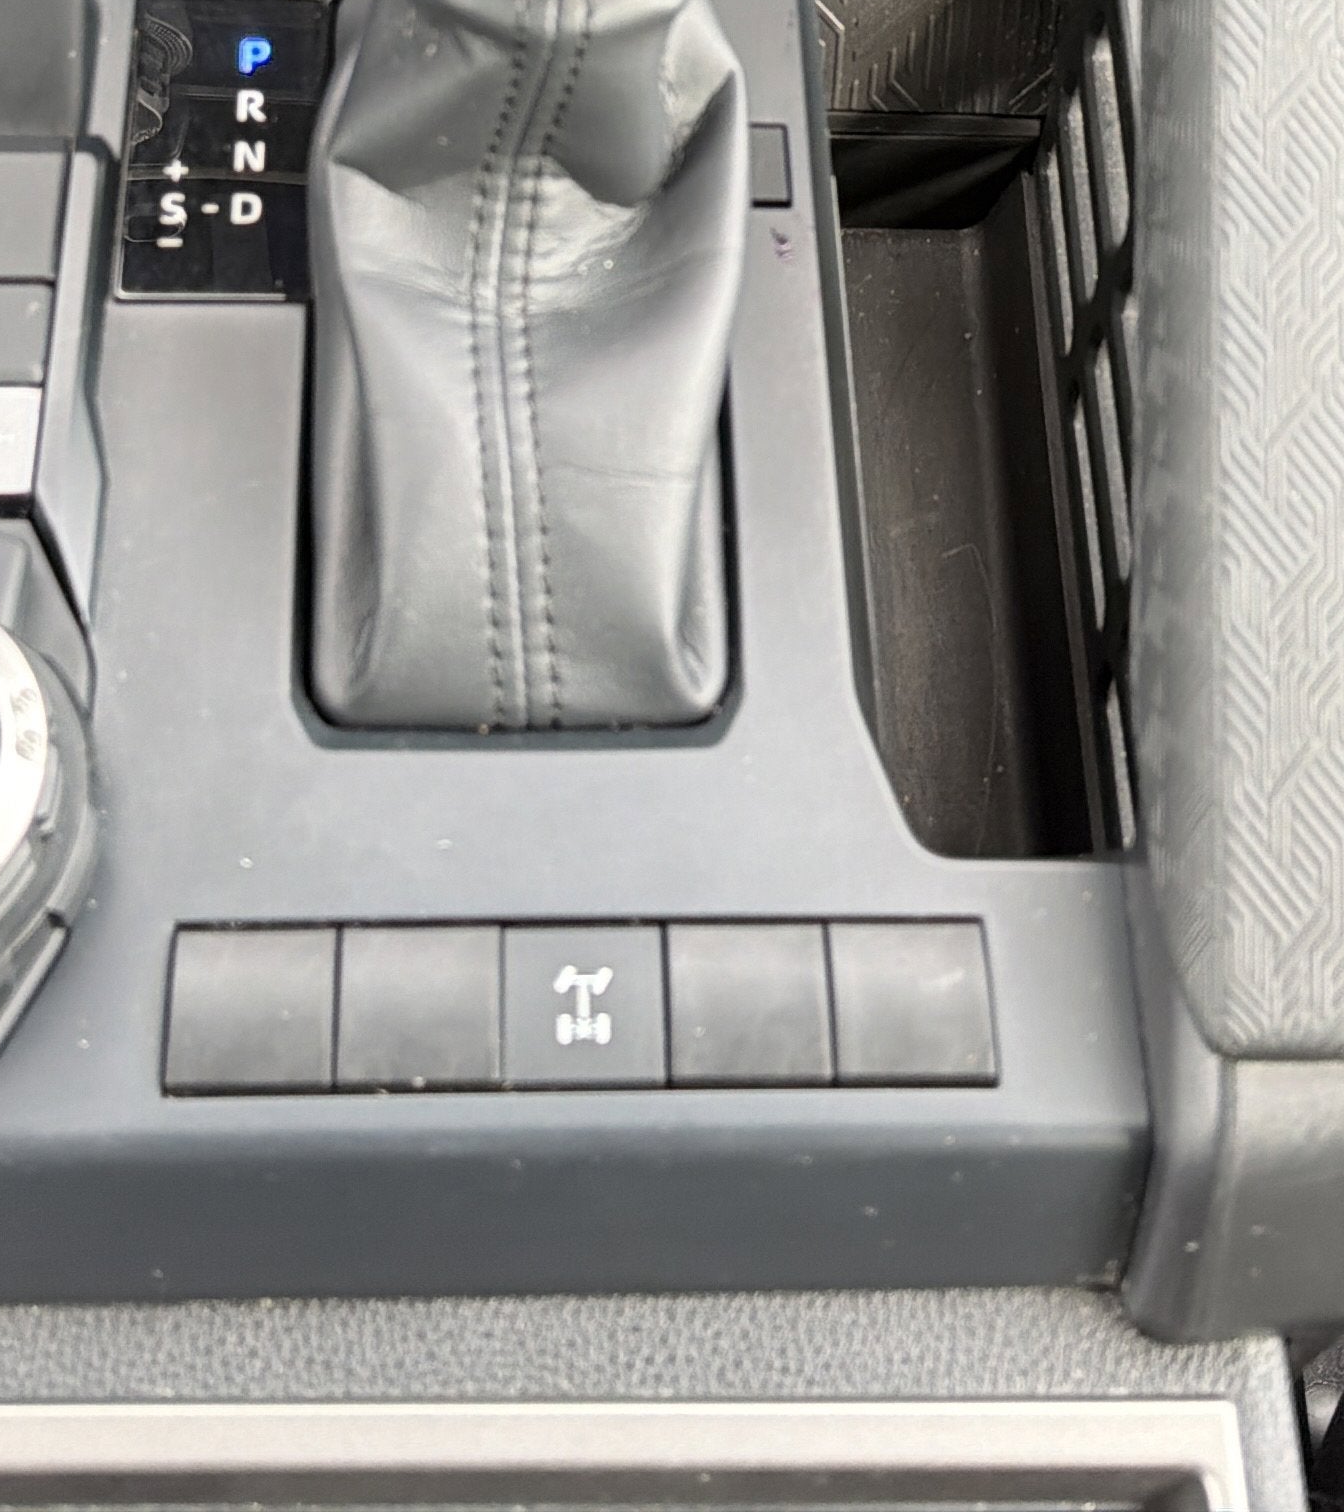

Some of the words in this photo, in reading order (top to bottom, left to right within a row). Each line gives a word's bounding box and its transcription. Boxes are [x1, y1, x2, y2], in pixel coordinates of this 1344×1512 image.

[237, 36, 273, 76] P
[236, 89, 267, 123] R
[233, 141, 266, 173] N
[158, 192, 187, 225] S
[229, 192, 263, 225] D
